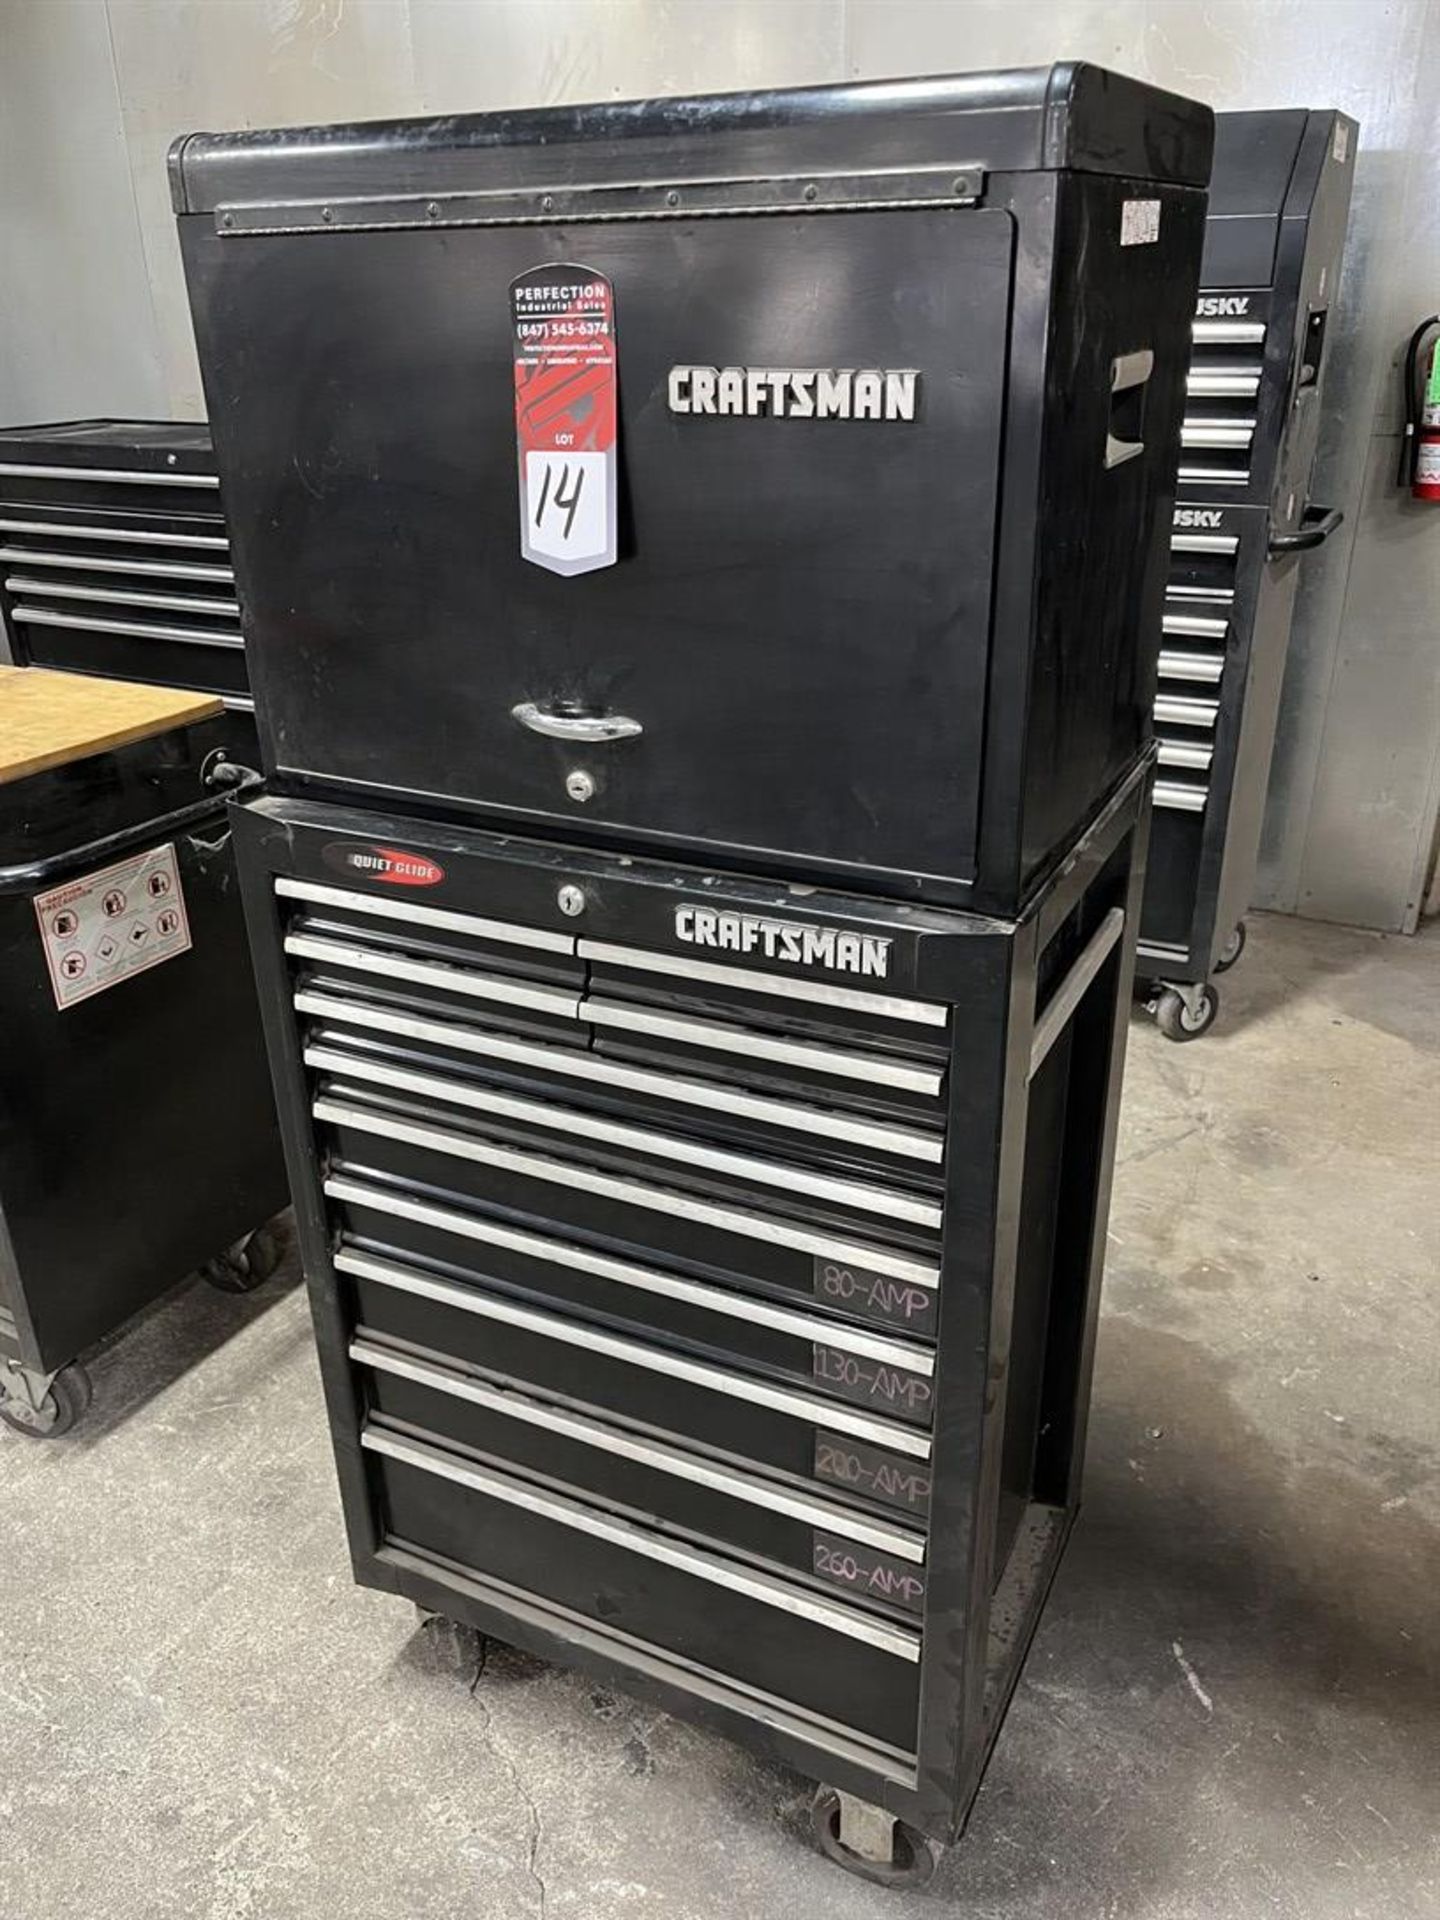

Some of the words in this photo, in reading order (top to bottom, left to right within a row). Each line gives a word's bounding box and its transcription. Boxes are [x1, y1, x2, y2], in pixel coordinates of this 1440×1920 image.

[515, 285, 605, 300] PERFECTION
[516, 301, 572, 312] Industrial
[576, 301, 606, 310] Sales
[517, 323, 549, 339] (847)
[551, 321, 609, 336] 545-6374
[668, 364, 921, 420] CRAFTSMAN
[555, 434, 574, 446] LOT
[535, 462, 584, 541] 14
[353, 854, 392, 871] QUIET
[395, 861, 435, 879] GLIDE
[674, 903, 893, 979] CRAFTSMAN
[824, 1265, 930, 1319] 80-AMP
[815, 1349, 931, 1408] 130-AMP
[818, 1444, 931, 1502] 200-AMP
[816, 1545, 924, 1600] 260-AMP
